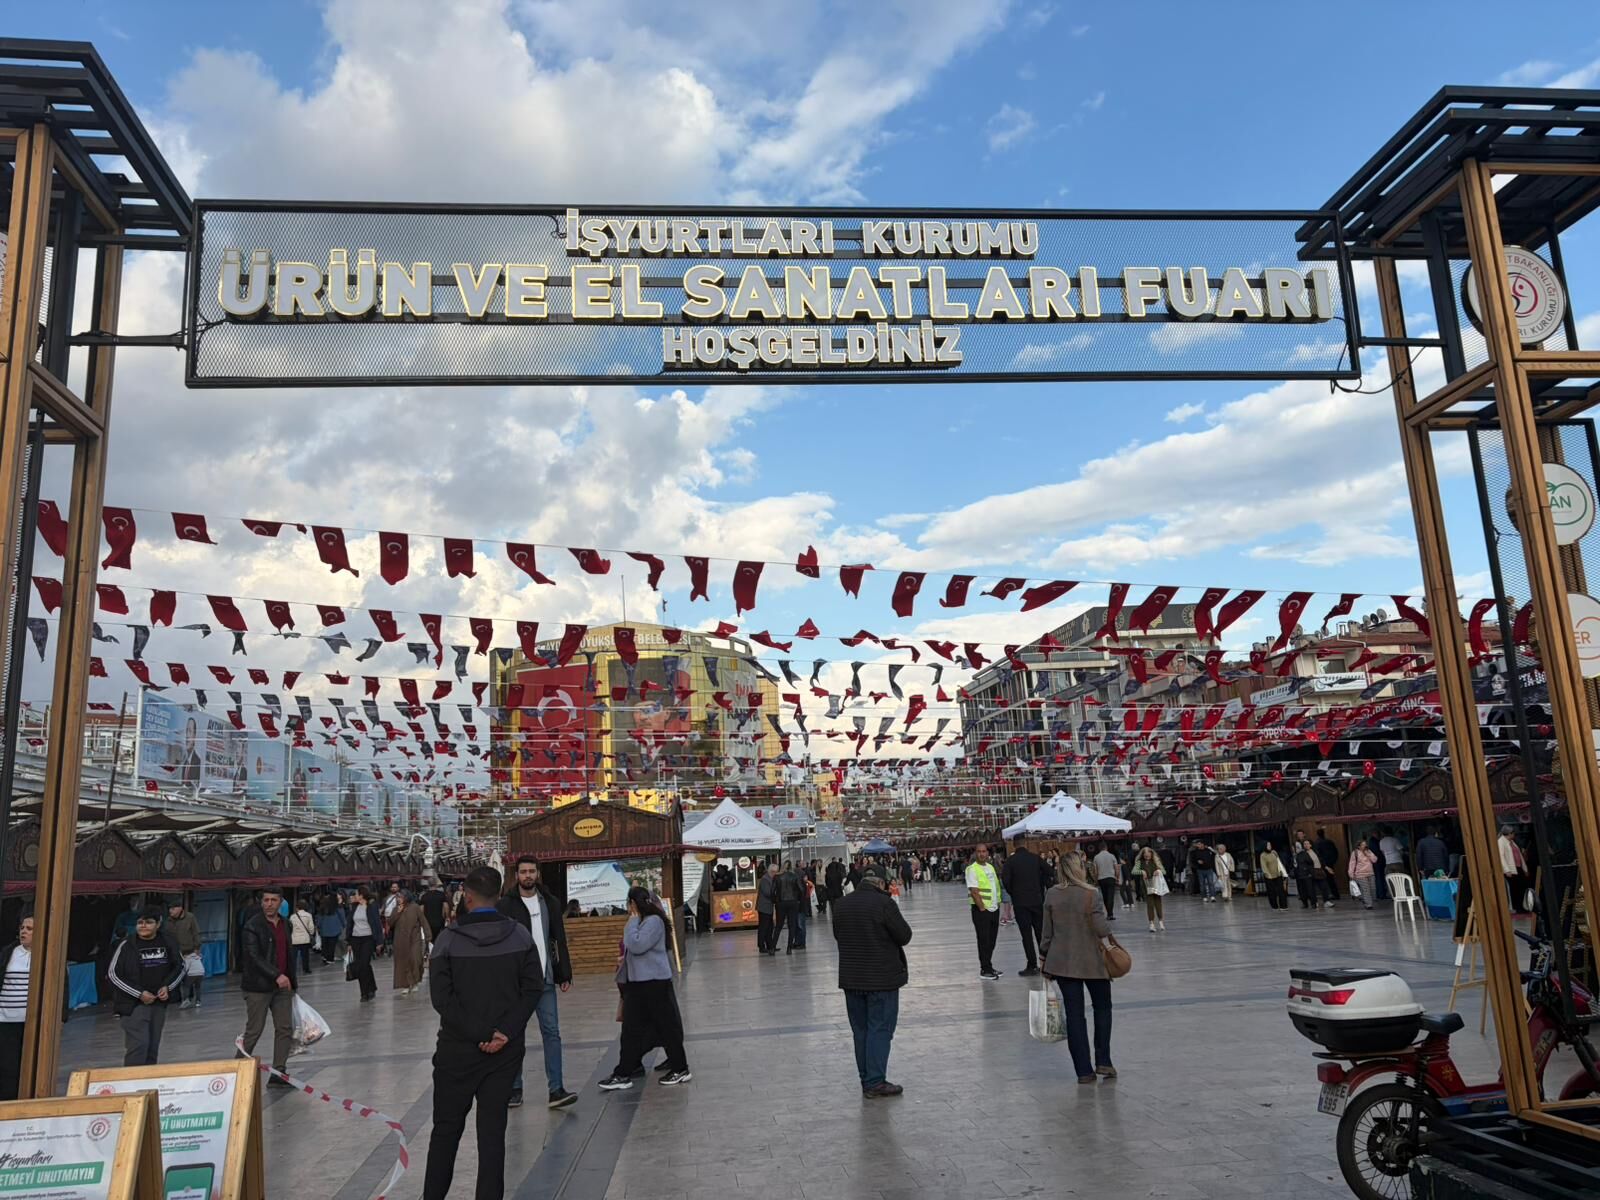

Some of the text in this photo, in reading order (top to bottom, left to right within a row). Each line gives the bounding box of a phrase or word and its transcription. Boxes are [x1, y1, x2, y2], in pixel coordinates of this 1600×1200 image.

[566, 208, 1038, 259] İŞYURTLARI KURUMU
[218, 247, 1333, 320] ÜRÜN VE EL SANATLARI FUARI
[1530, 299, 1557, 335] KURUMU
[662, 319, 963, 370] HOŞGELDİNİZ
[1550, 495, 1572, 509] AN
[1574, 631, 1591, 644] ER
[1401, 695, 1425, 712] KING
[170, 1116, 217, 1130] UNUTMAYIN
[37, 1167, 96, 1184] UNUTMAYIN
